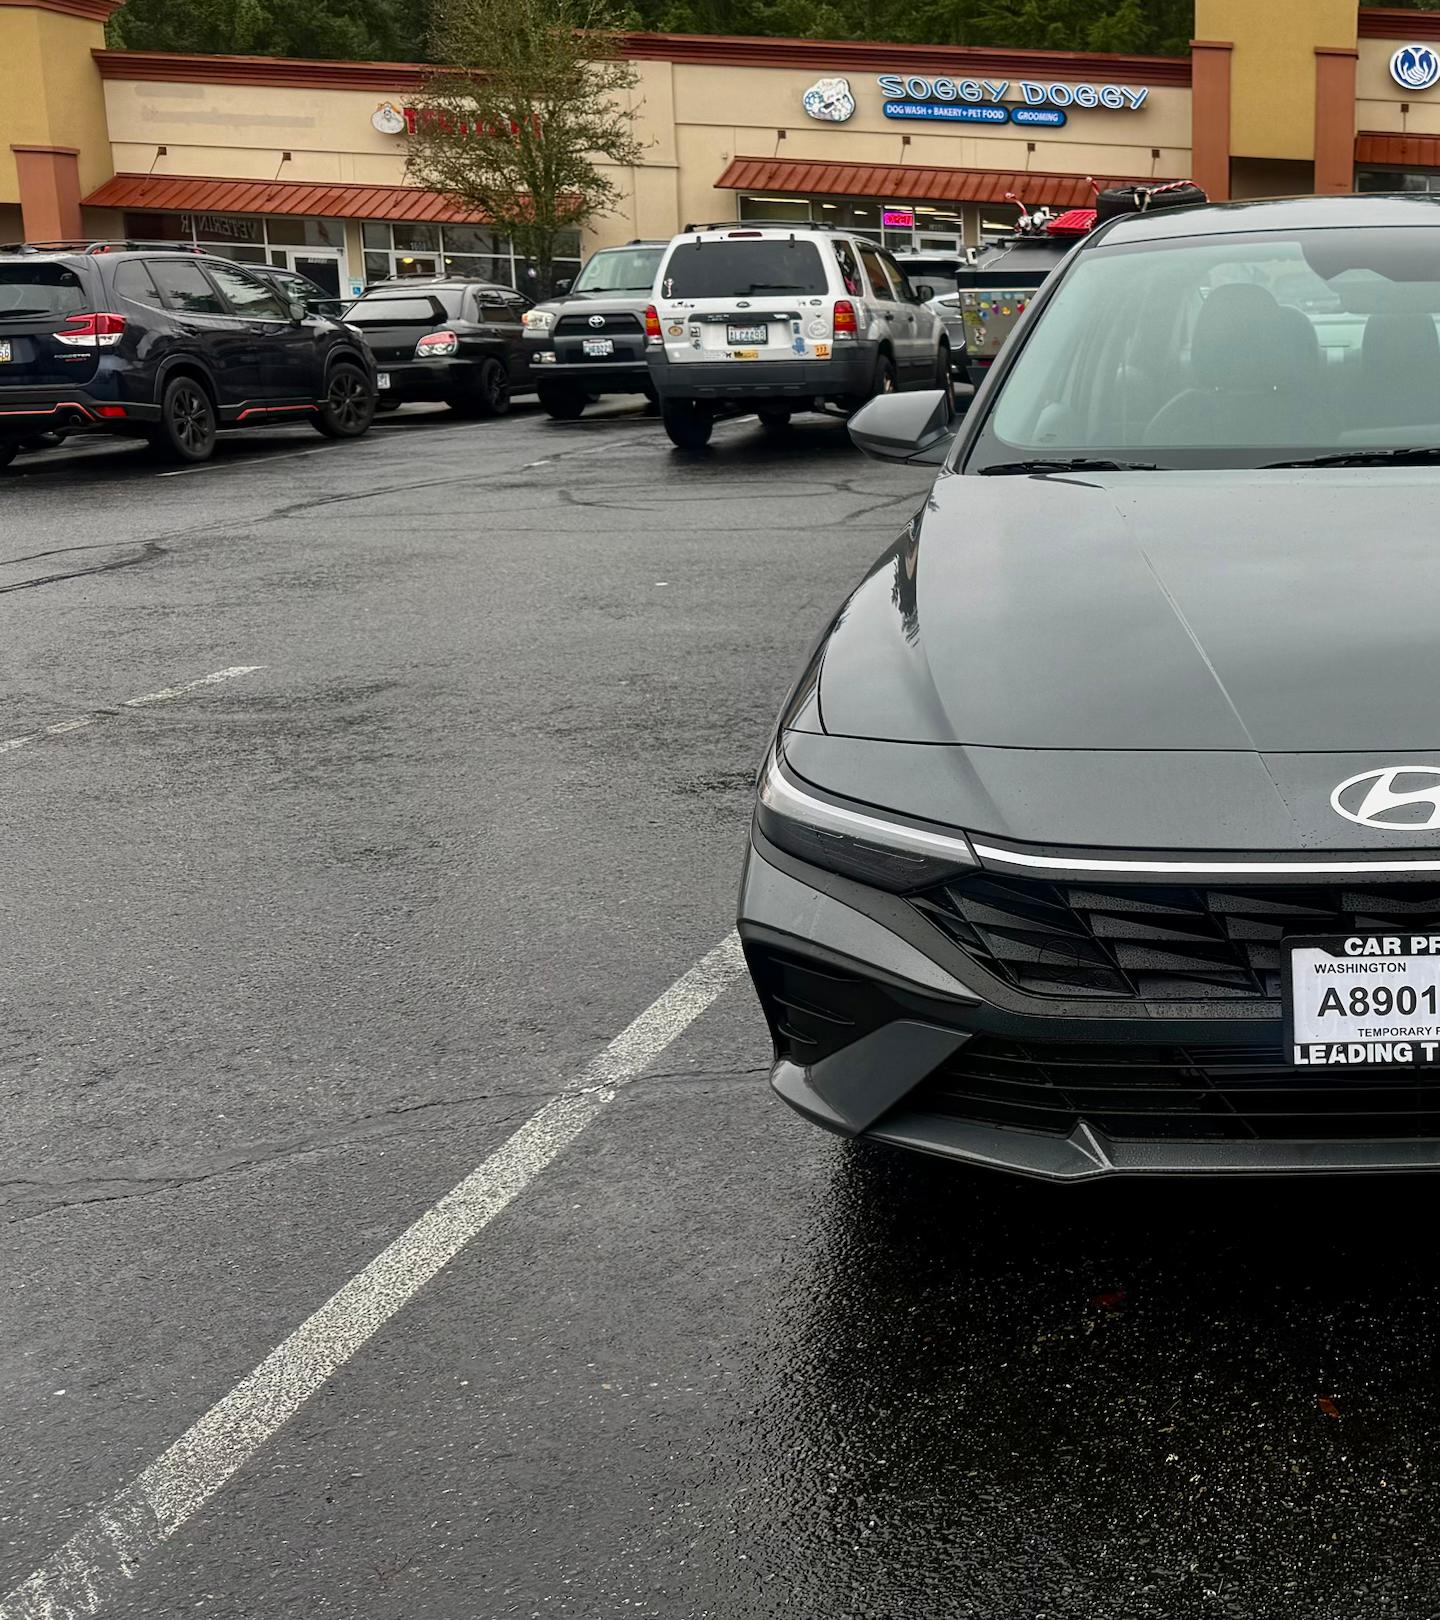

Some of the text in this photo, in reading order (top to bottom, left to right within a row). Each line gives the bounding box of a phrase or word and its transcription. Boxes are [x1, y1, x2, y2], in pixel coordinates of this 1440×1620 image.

[877, 75, 1149, 109] SOGGY DOGGY
[886, 105, 1005, 119] DOG WASH BAKERY PET FOOD
[1017, 111, 1059, 122] GROOMING
[1343, 937, 1402, 956] CAR
[1314, 962, 1407, 974] WASHINGTON
[1358, 1027, 1432, 1038] TEMPORARY
[1294, 1042, 1413, 1065] LEADING
